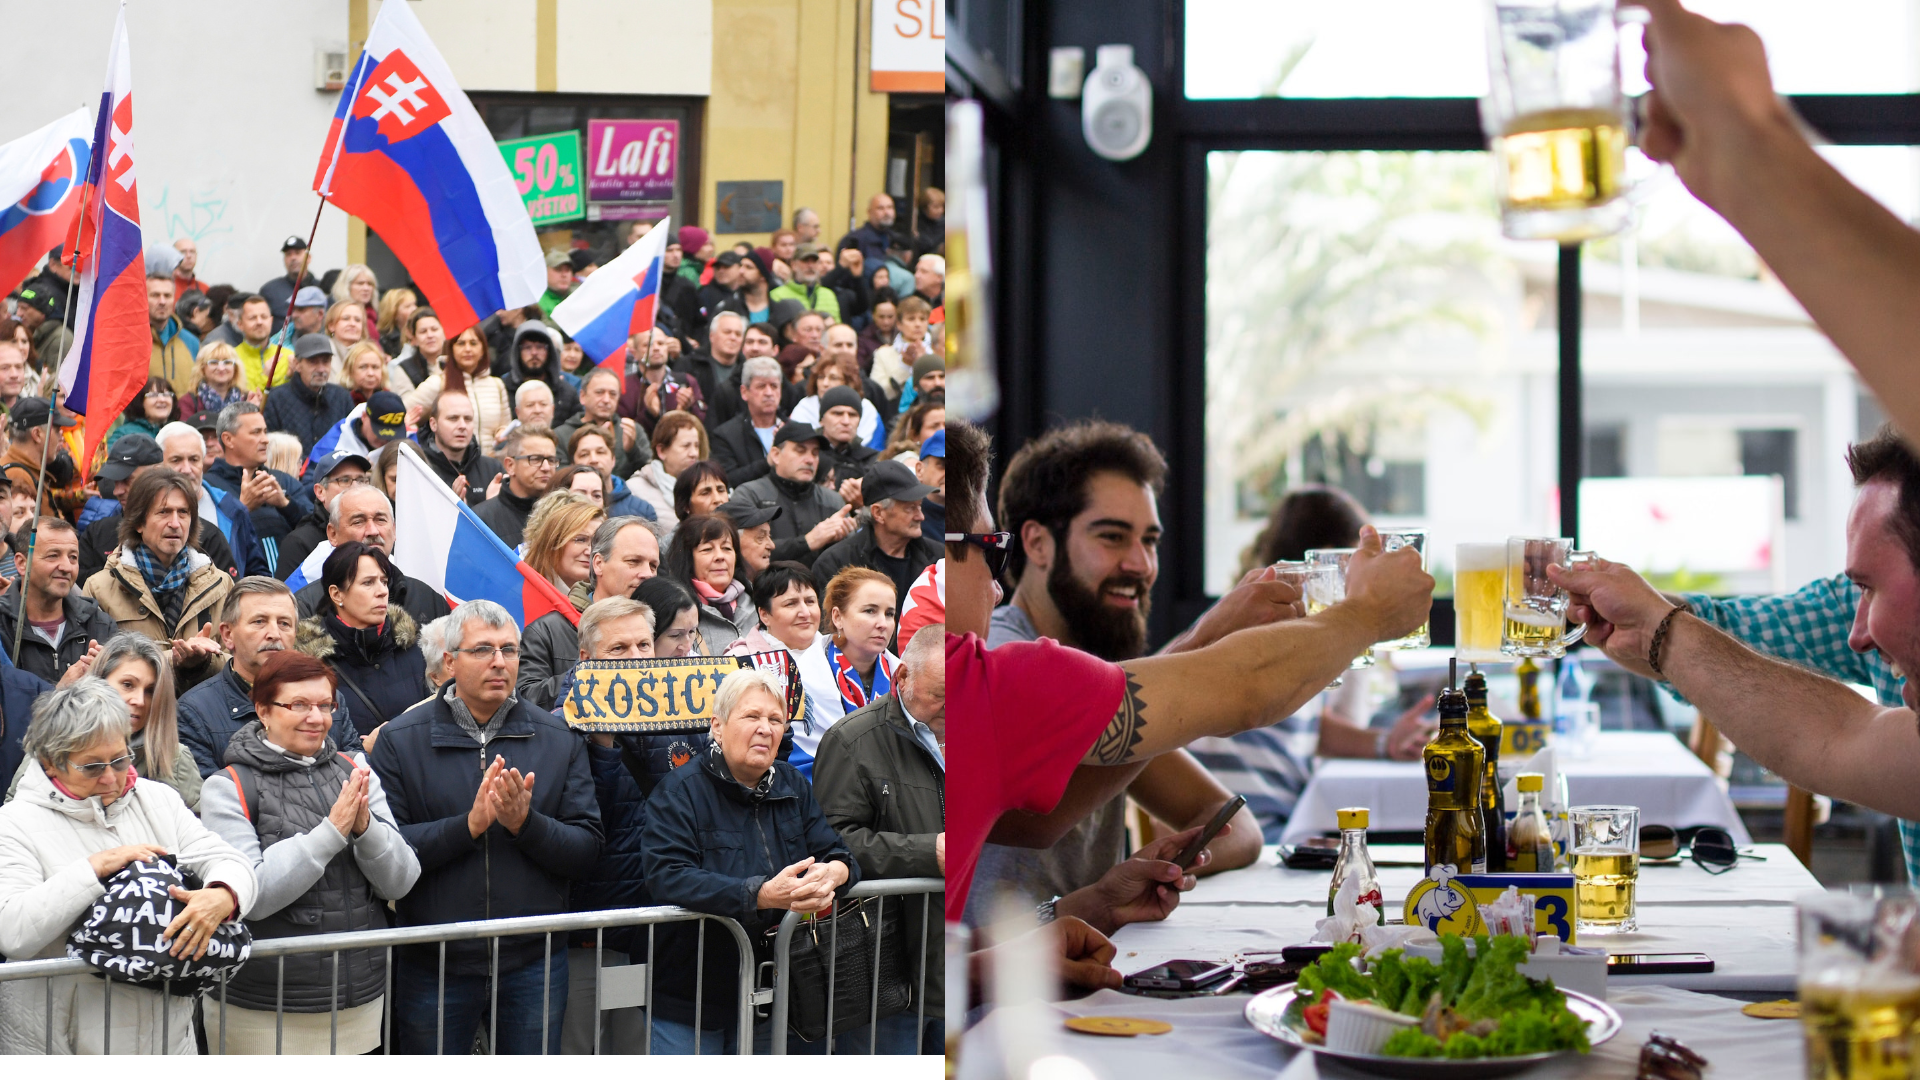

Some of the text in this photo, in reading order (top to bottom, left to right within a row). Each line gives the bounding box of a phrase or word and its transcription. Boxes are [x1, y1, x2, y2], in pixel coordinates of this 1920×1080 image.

[595, 126, 673, 176] Lafi
[527, 193, 578, 219] VŠETKO
[378, 412, 405, 425] 46
[1512, 729, 1547, 751] 05
